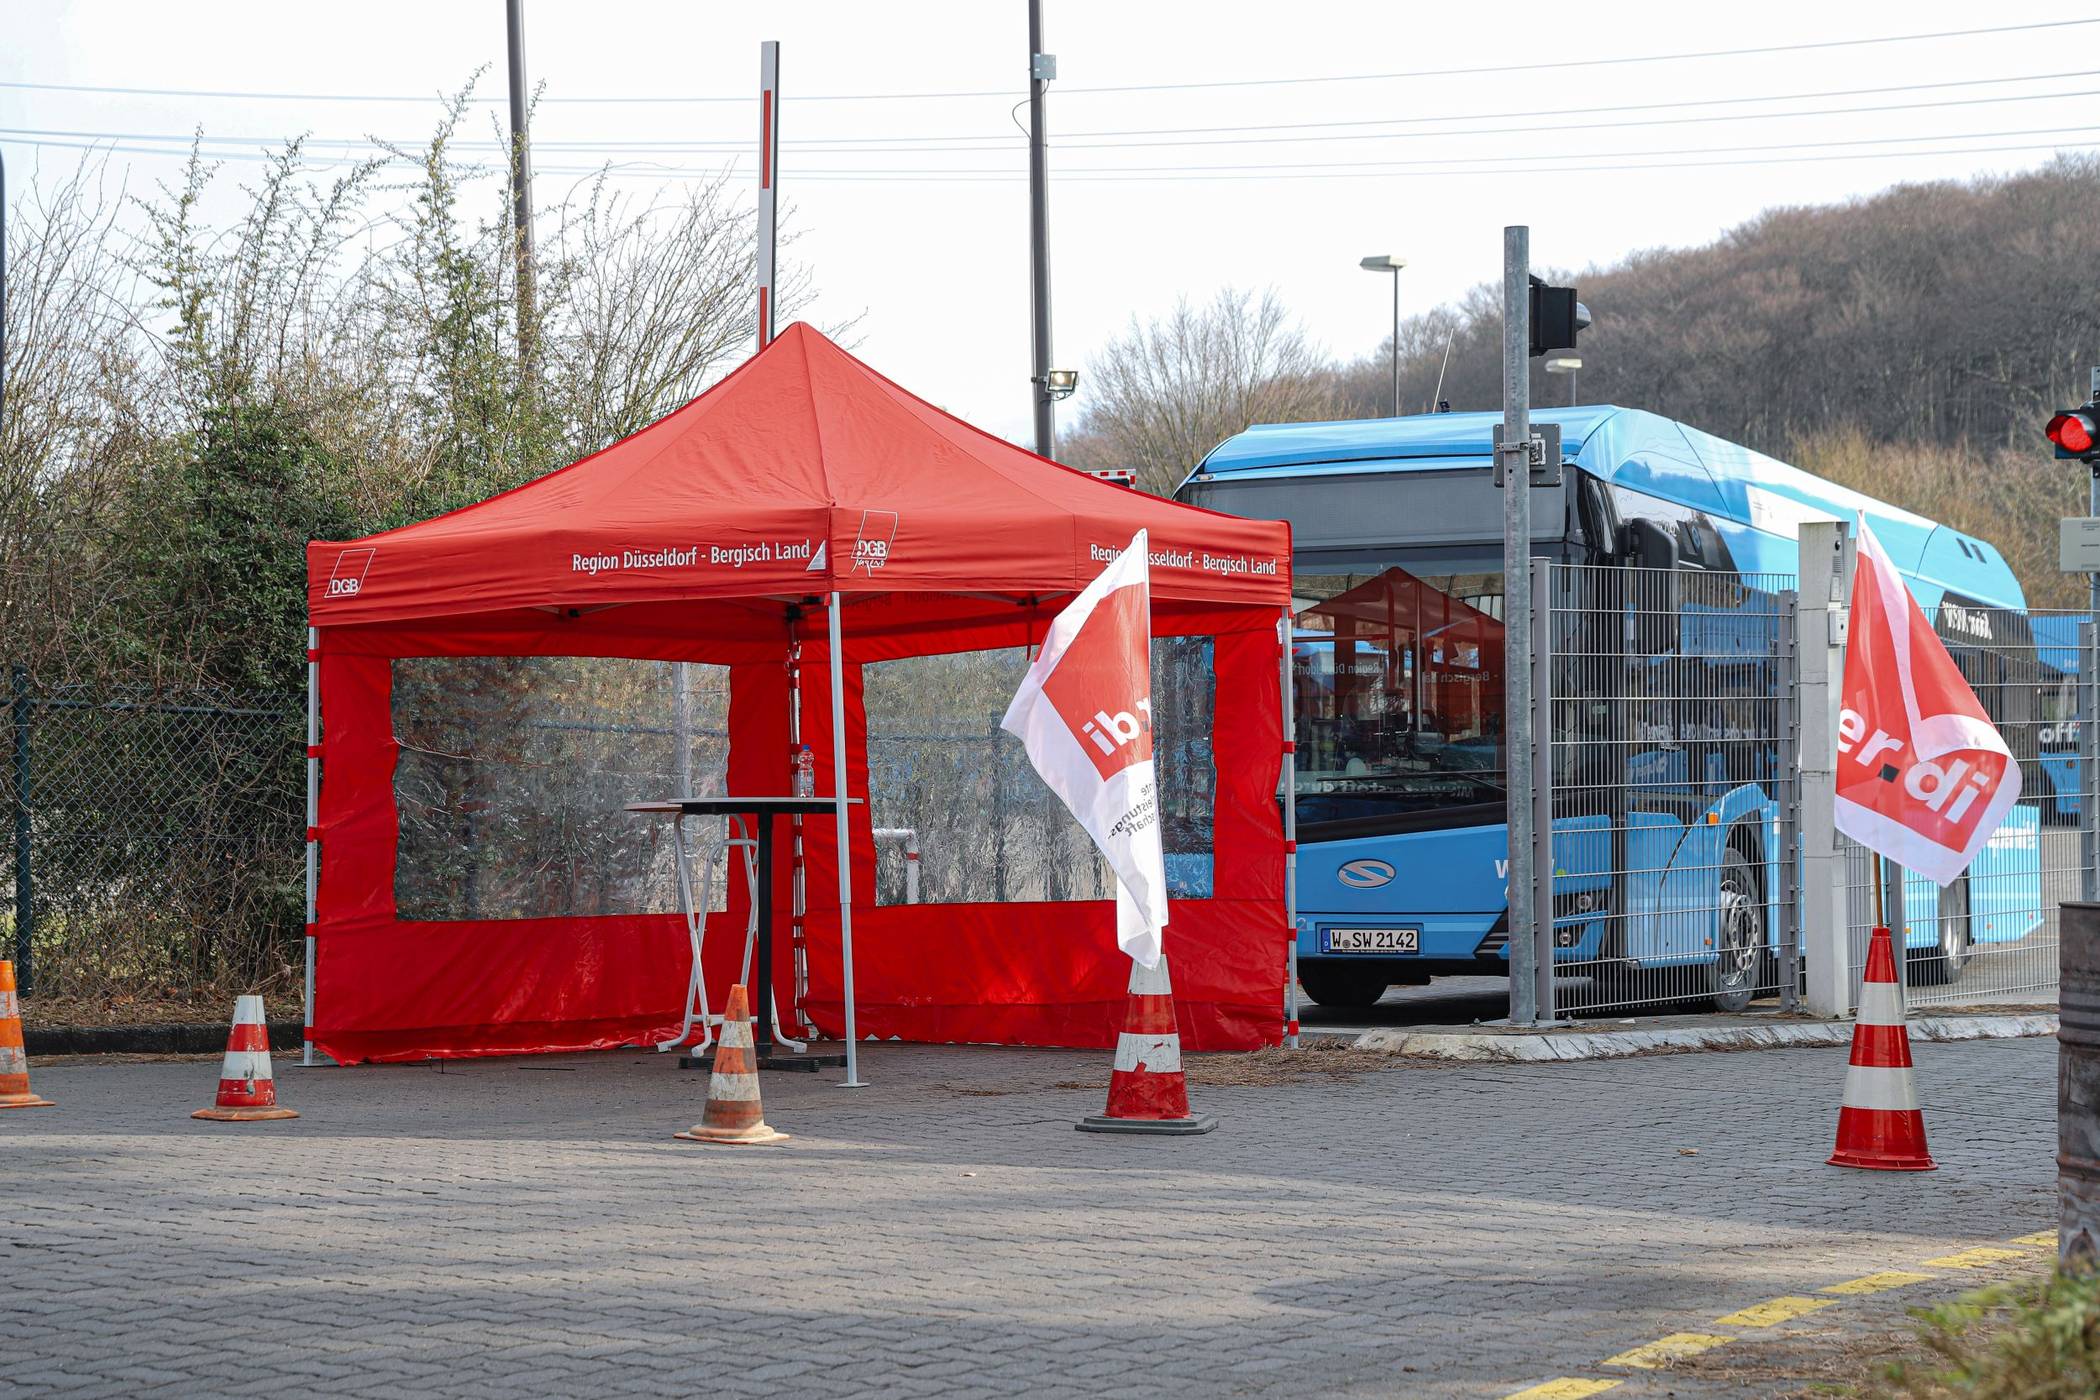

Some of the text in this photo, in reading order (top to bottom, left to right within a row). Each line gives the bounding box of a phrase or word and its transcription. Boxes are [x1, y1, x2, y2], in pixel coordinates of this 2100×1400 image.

[572, 554, 619, 575] Region
[623, 546, 698, 568] Düsseldorf
[711, 543, 770, 568] Bergisch
[775, 539, 810, 560] Land
[858, 540, 887, 557] DGB
[1090, 543, 1121, 566] Regio
[1203, 554, 1248, 575] Bergisch
[1251, 558, 1276, 575] Land
[331, 578, 359, 594] DGB
[1332, 932, 1415, 948] W SW 2142
